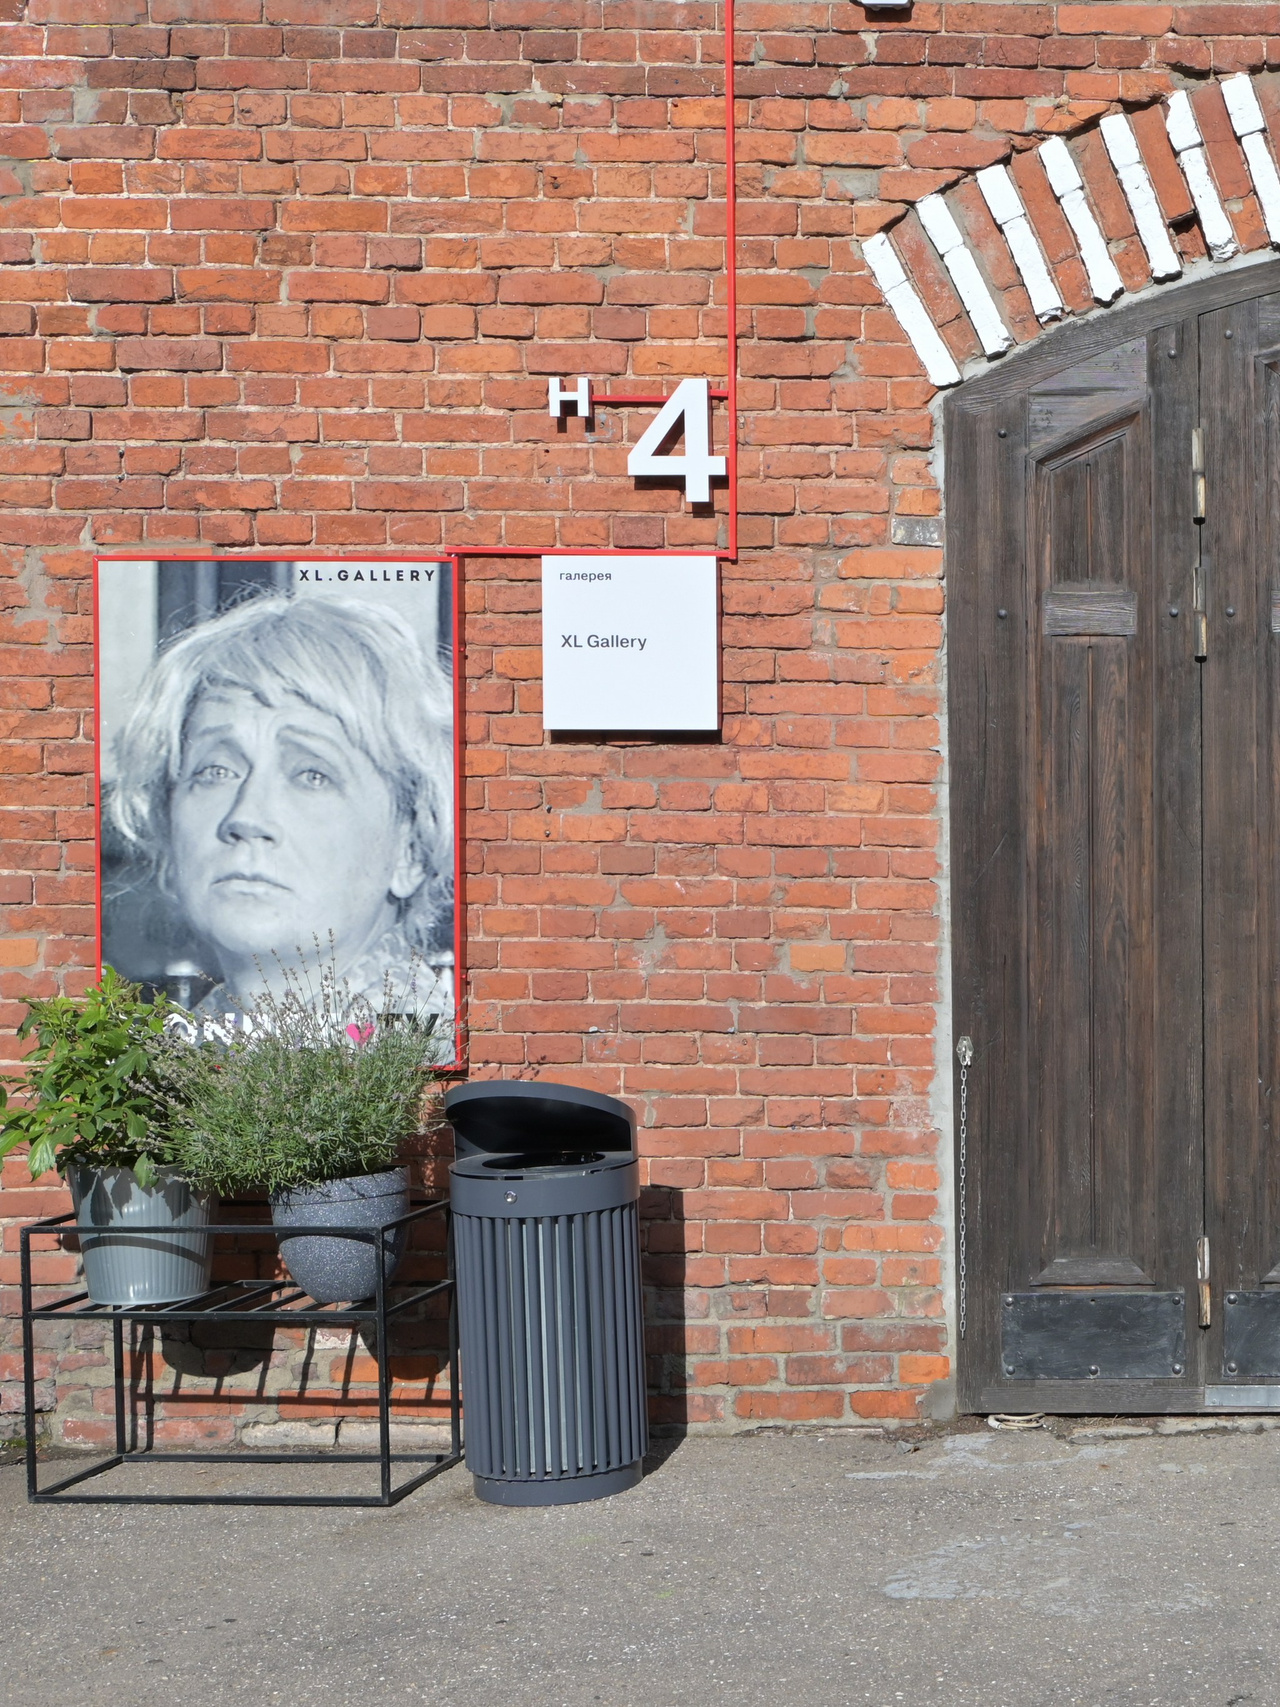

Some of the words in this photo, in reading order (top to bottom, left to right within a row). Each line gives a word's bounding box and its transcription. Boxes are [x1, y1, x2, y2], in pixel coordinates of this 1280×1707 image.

[627, 378, 728, 503] 4
[298, 569, 437, 582] XL.GALLERY
[559, 571, 612, 583] галерея
[560, 634, 583, 649] XL
[586, 633, 647, 651] Gallery
